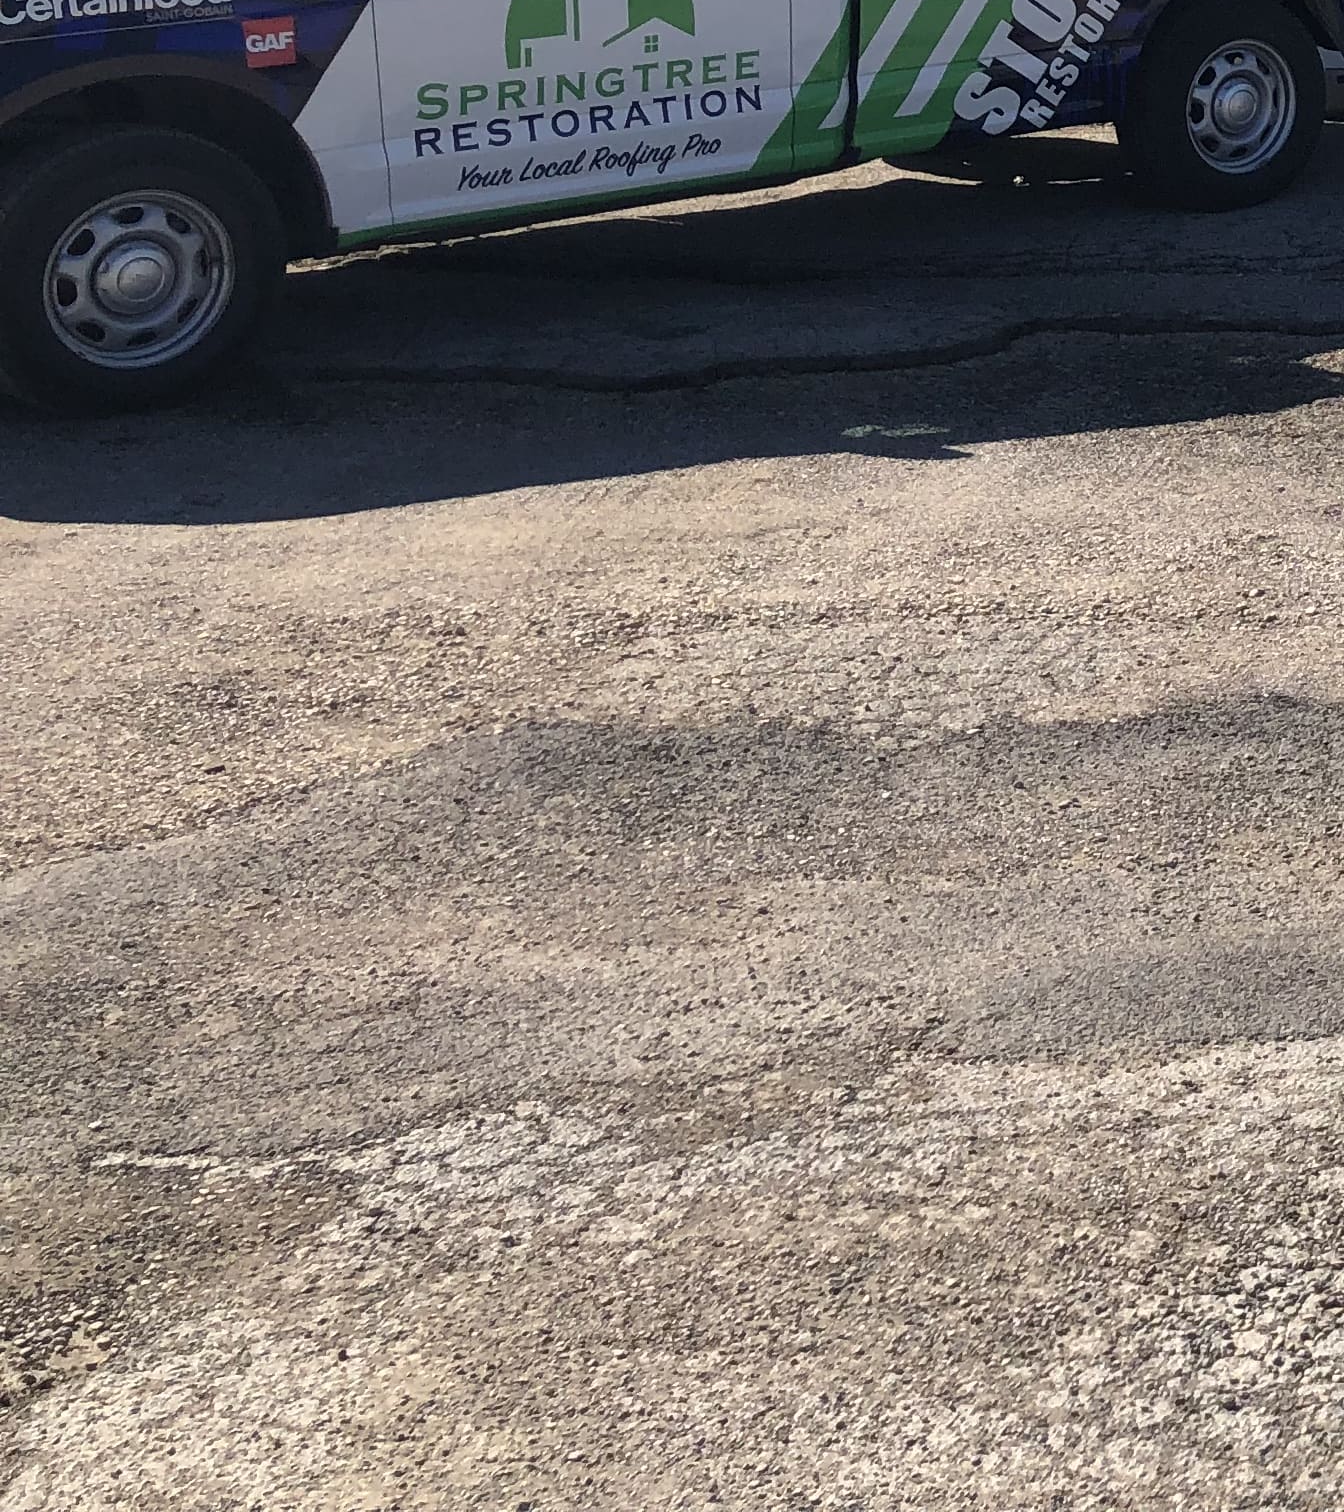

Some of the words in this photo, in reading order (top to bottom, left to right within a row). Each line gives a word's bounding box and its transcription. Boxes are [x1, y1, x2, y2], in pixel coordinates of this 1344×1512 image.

[145, 3, 234, 23] SAINT-GOBAIN
[245, 31, 294, 54] GAF
[415, 48, 761, 121] SPRINGTREE
[413, 84, 763, 159] RESTORATION
[457, 163, 514, 192] Your
[519, 148, 585, 183] Local
[588, 138, 676, 178] Roofing
[681, 132, 722, 157] Pro
